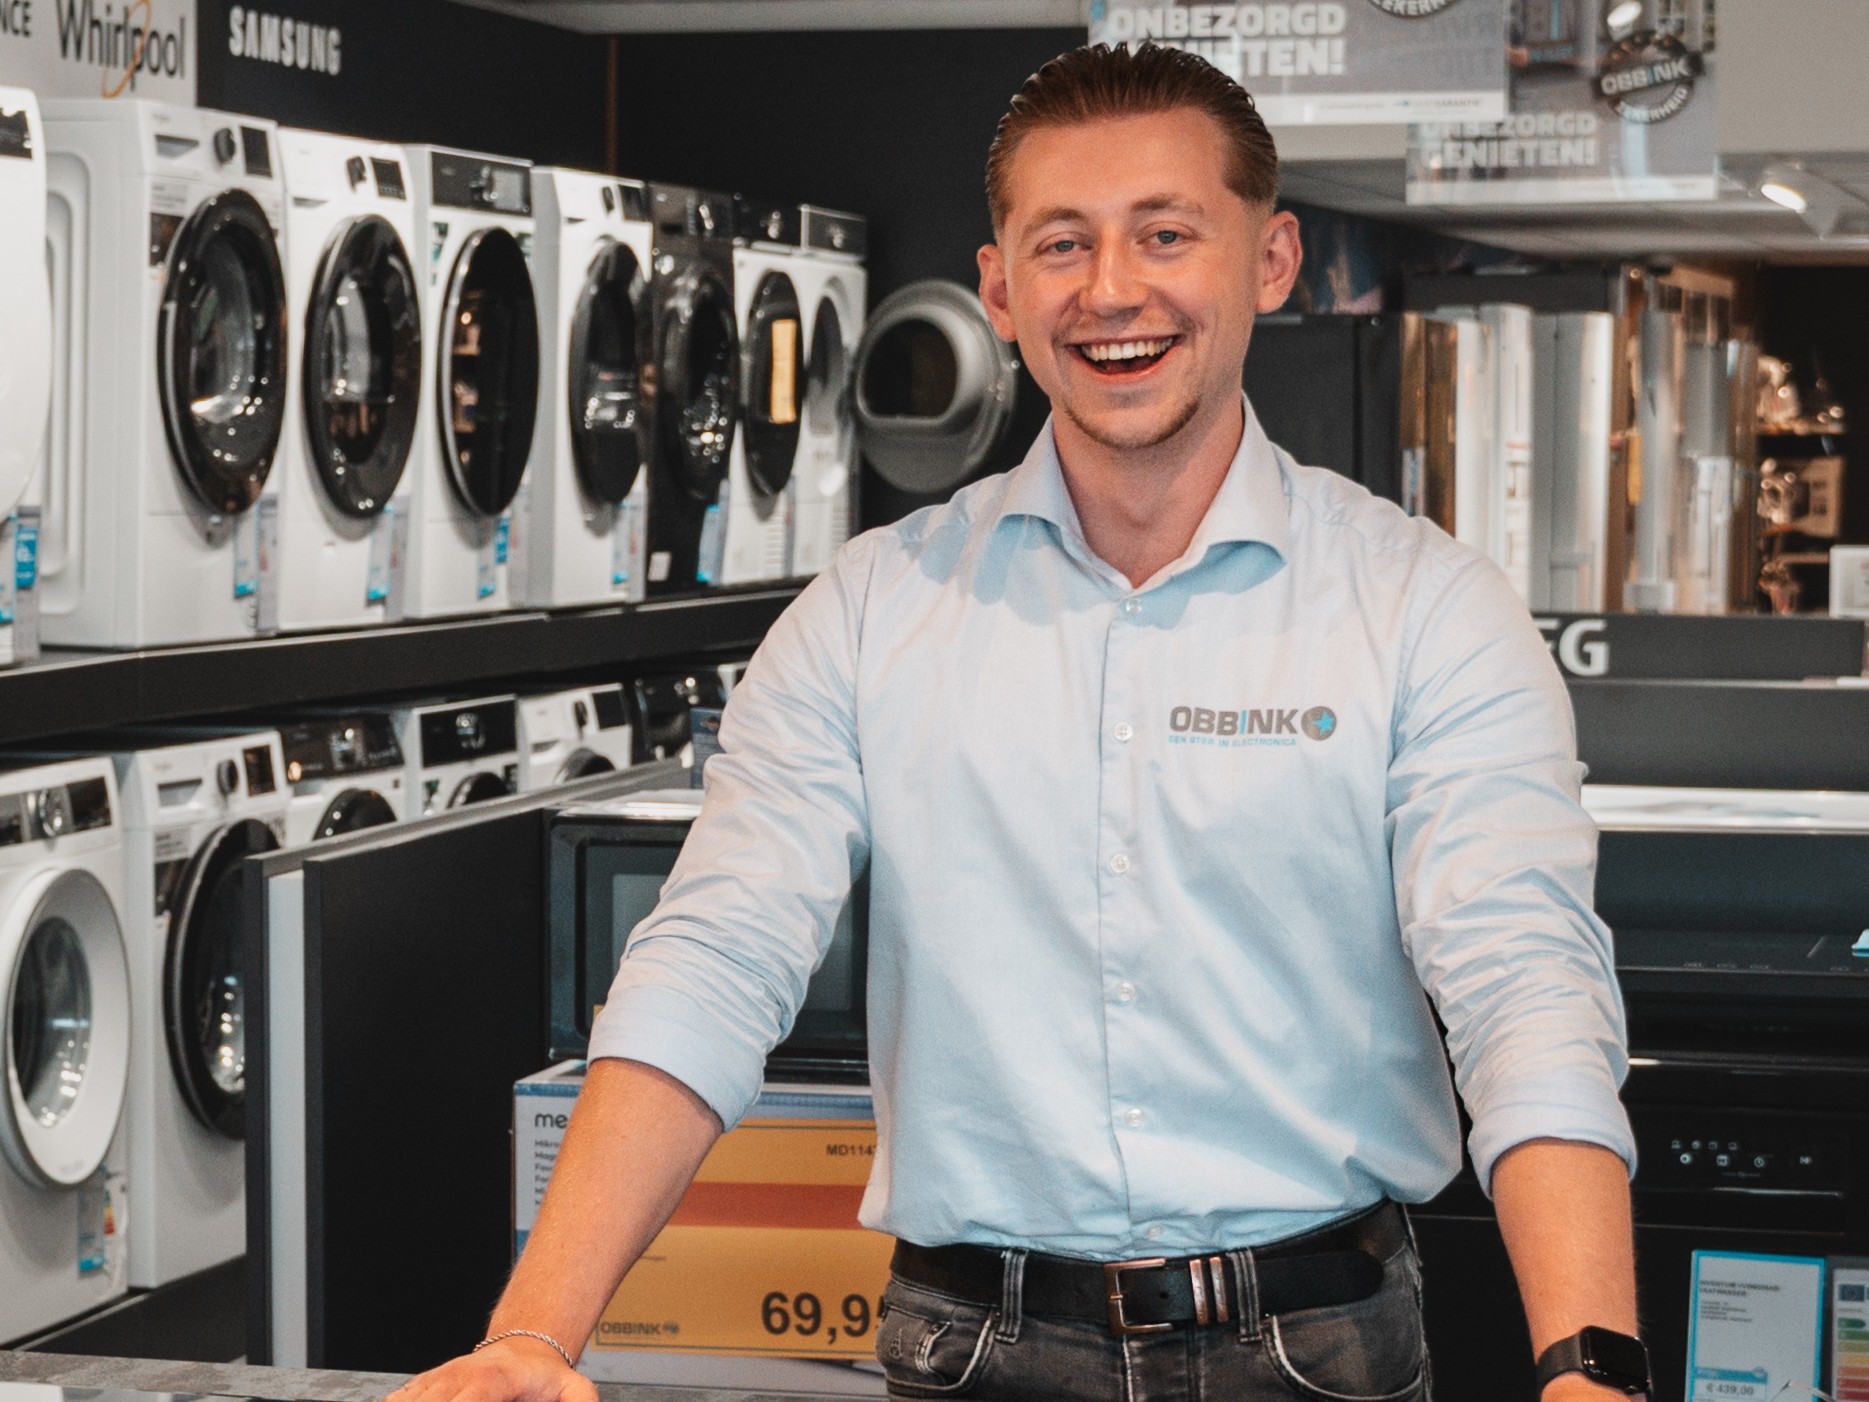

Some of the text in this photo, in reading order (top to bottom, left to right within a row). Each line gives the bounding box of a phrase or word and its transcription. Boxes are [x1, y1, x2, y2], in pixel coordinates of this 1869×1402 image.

[1108, 4, 1346, 40] ONBEZORGD
[57, 0, 186, 92] Whirlpool
[229, 5, 342, 76] SAMSUNG
[1601, 58, 1690, 95] OBBINK
[1169, 706, 1299, 736] OBBINK
[1219, 739, 1229, 747] IN
[600, 1322, 661, 1335] OBBINK
